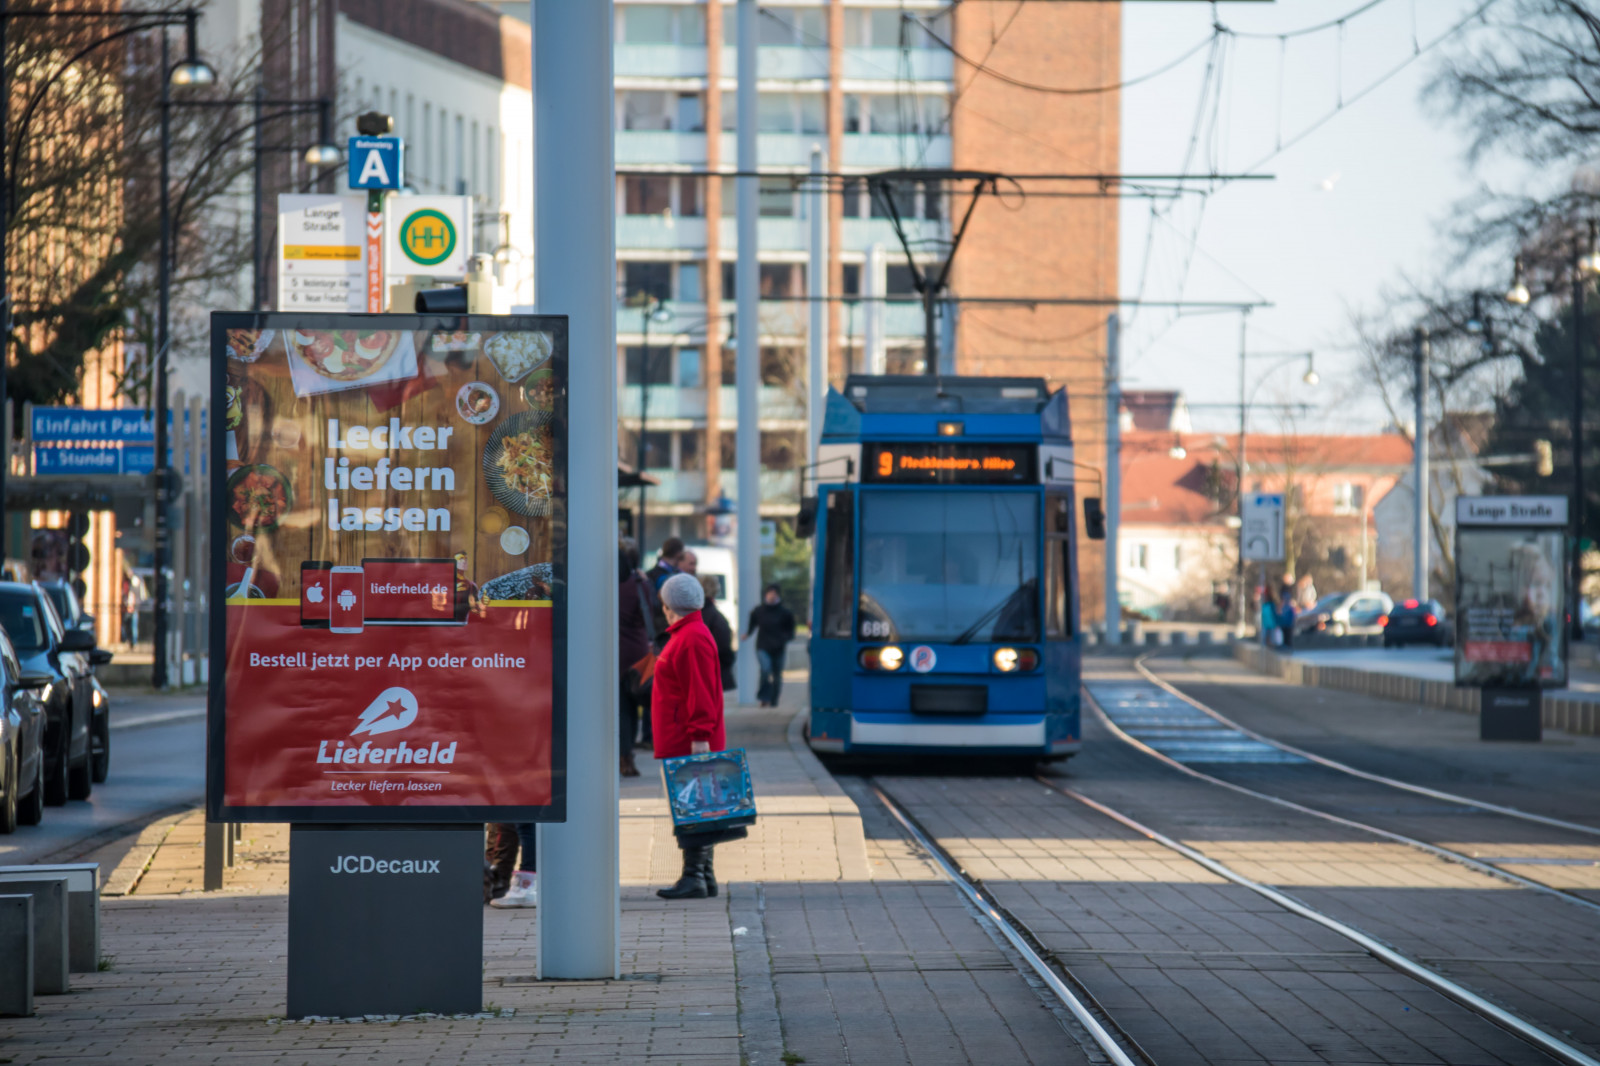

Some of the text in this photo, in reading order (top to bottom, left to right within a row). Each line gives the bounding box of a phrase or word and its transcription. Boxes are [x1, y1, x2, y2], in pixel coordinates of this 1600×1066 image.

[358, 149, 390, 184] A
[304, 208, 339, 219] Lange
[303, 221, 340, 231] Straße
[36, 416, 106, 434] Einfahrt
[328, 417, 453, 450] Lecker
[59, 451, 115, 467] Stunde
[878, 451, 893, 476] 9
[324, 457, 455, 490] liefern
[328, 498, 450, 531] lassen
[1469, 503, 1506, 519] Lange
[370, 583, 448, 595] lieferheld.de
[862, 620, 890, 637] 689
[249, 652, 526, 671] Bestell jetzt per App oder online
[316, 740, 458, 764] Lieferheld
[331, 780, 442, 793] Lecker liefern lassen
[330, 855, 440, 874] JCDecaux
